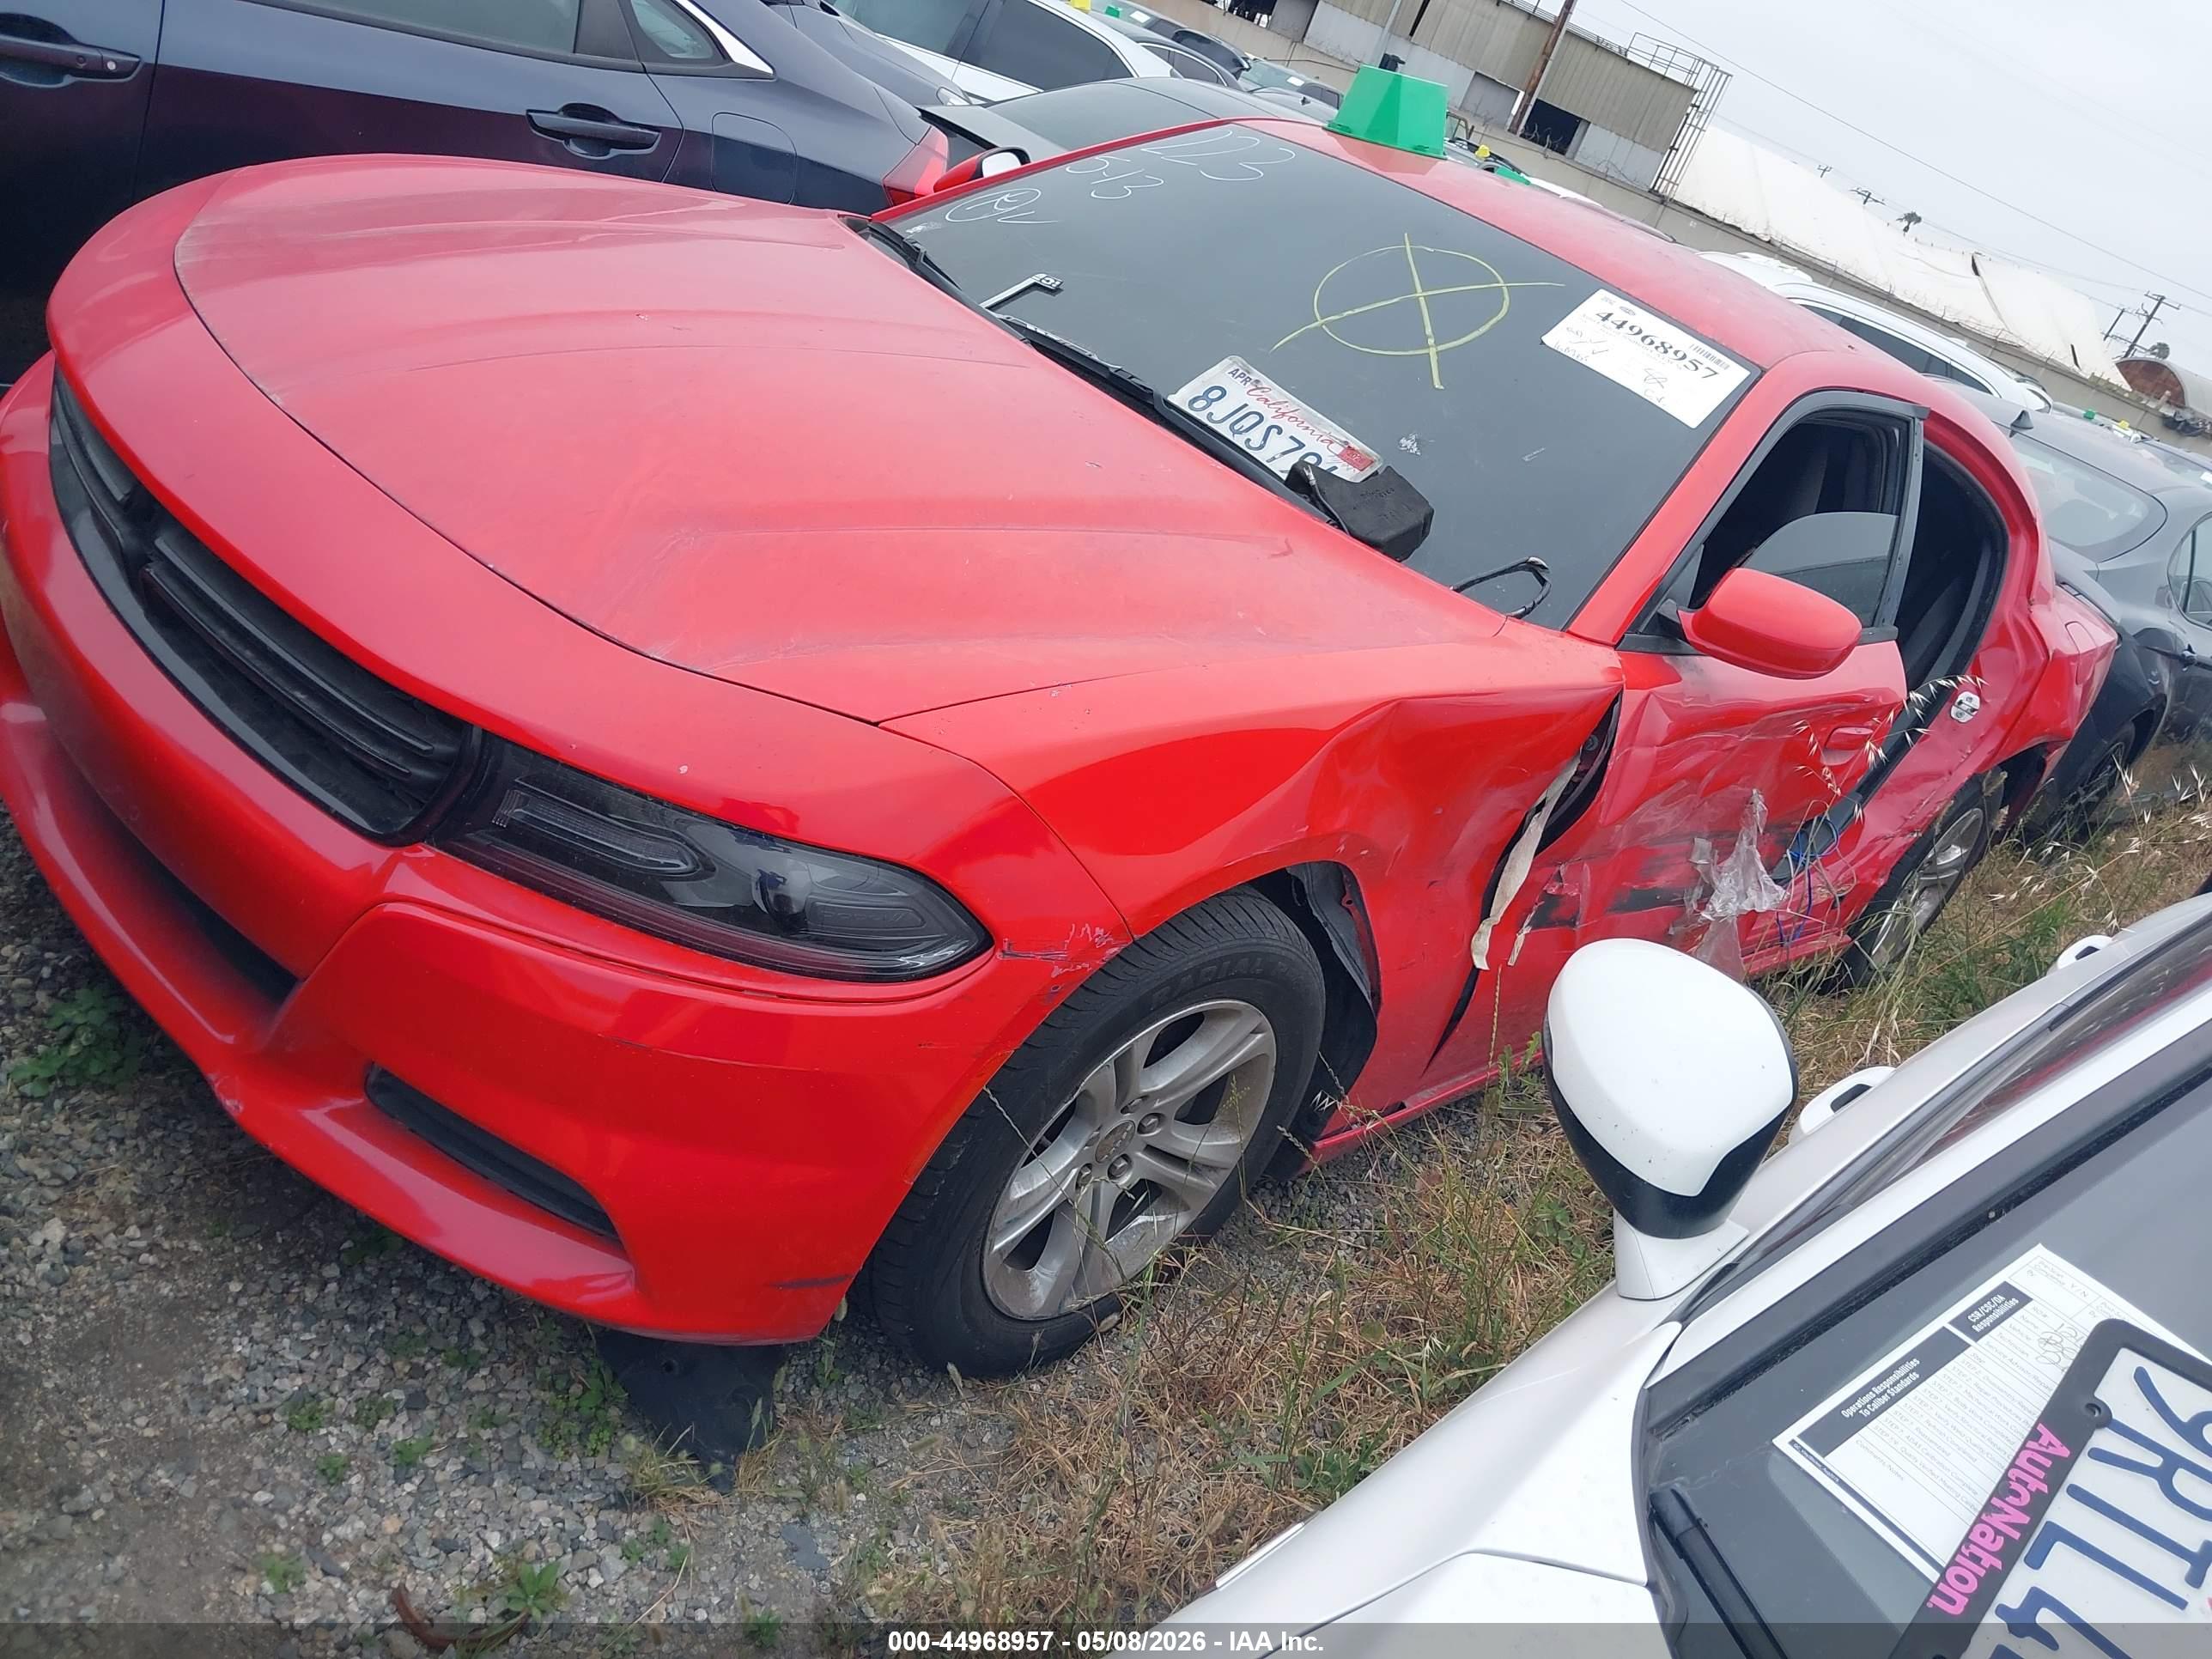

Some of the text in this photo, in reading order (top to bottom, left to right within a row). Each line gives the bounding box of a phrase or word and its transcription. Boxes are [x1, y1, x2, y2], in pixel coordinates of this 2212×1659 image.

[1595, 308, 1718, 380] 44968957
[1228, 368, 1253, 386] APR
[1247, 384, 1338, 456] California
[1972, 1297, 2019, 1332] Responsibilities
[1840, 1357, 1921, 1419] Operations Responsibilities
[1859, 1370, 1920, 1418] To Caliber Standards
[1936, 1422, 2071, 1616] AutoNation
